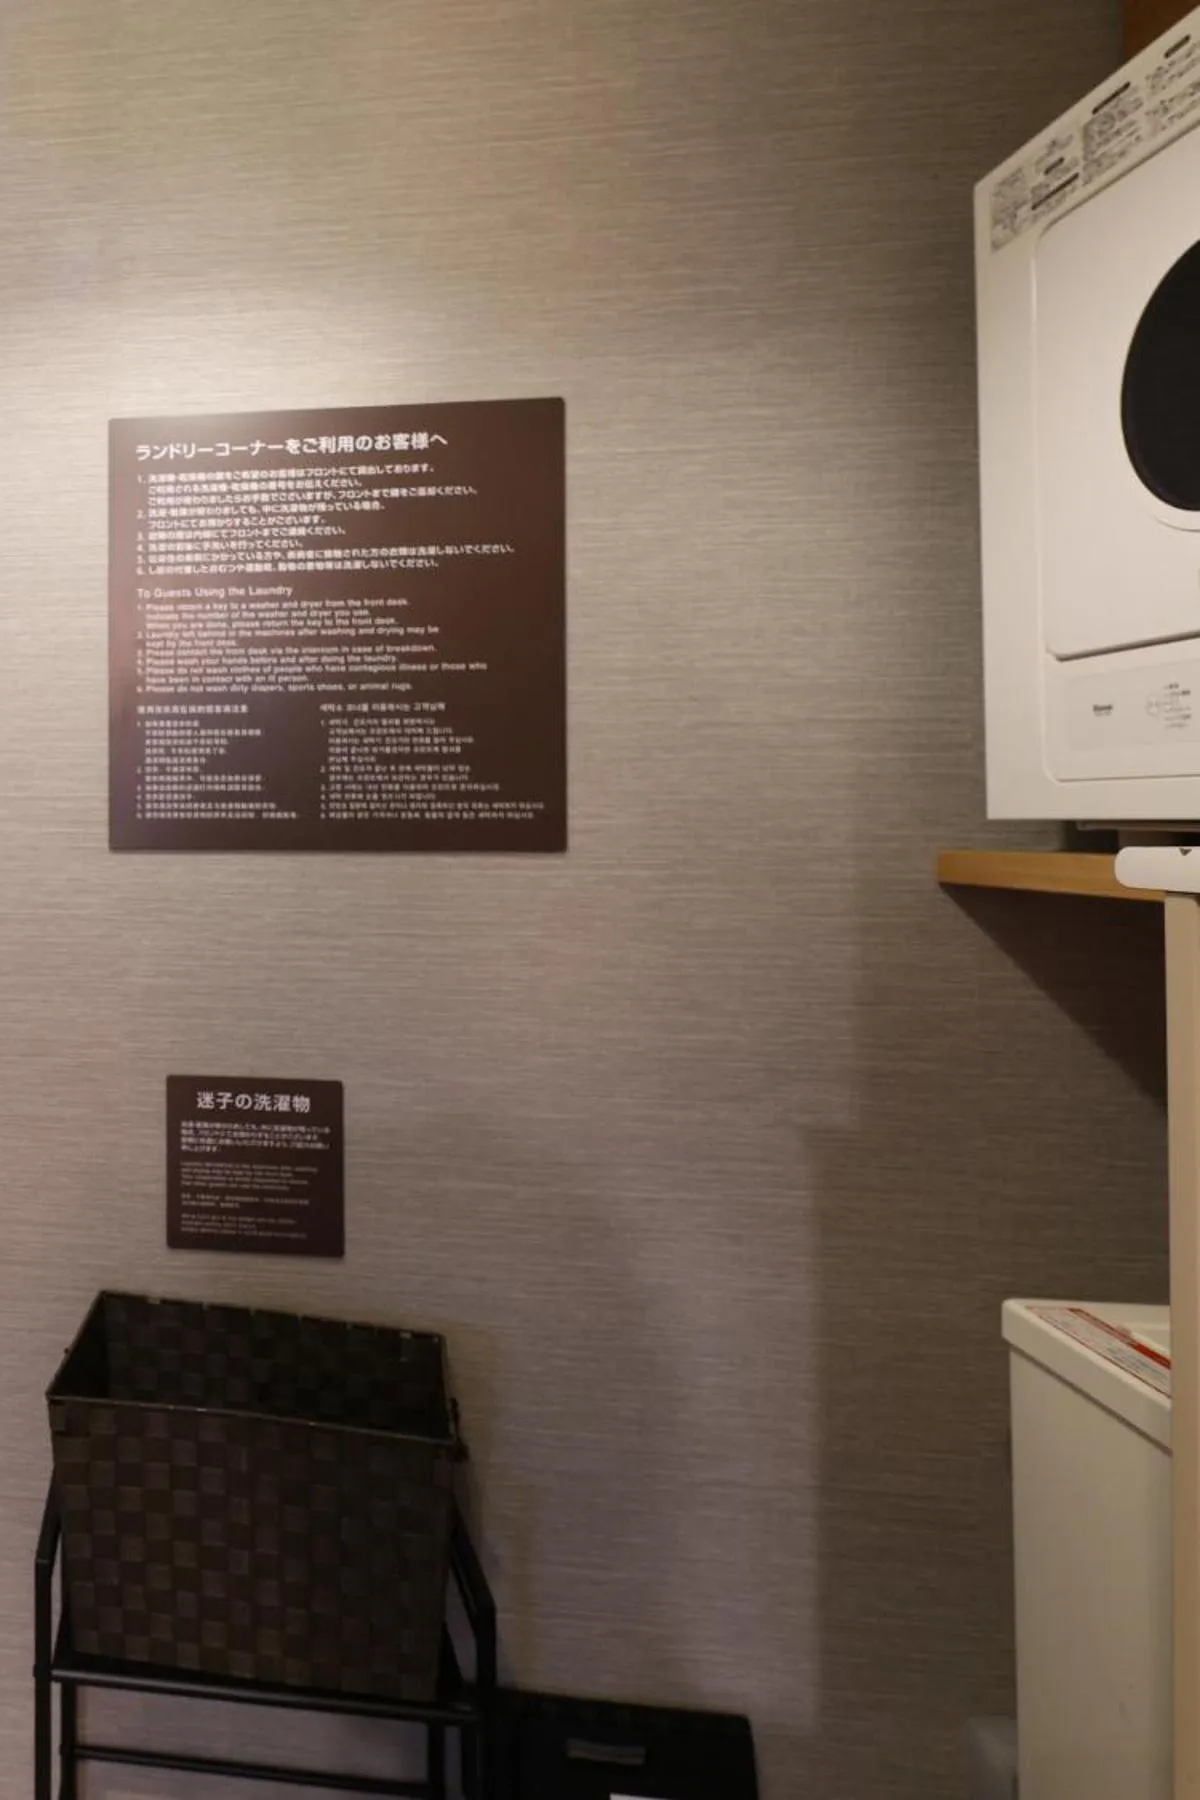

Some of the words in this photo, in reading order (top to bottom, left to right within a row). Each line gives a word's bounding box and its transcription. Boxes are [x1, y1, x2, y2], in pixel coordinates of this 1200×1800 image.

[136, 432, 449, 461] ランドリーコーナーをご利用のお客様へ
[154, 587, 191, 597] Guests
[195, 586, 225, 598] Using
[228, 585, 245, 595] the
[249, 584, 293, 597] Laundry
[197, 1091, 311, 1113] 迷子の洗濯物
